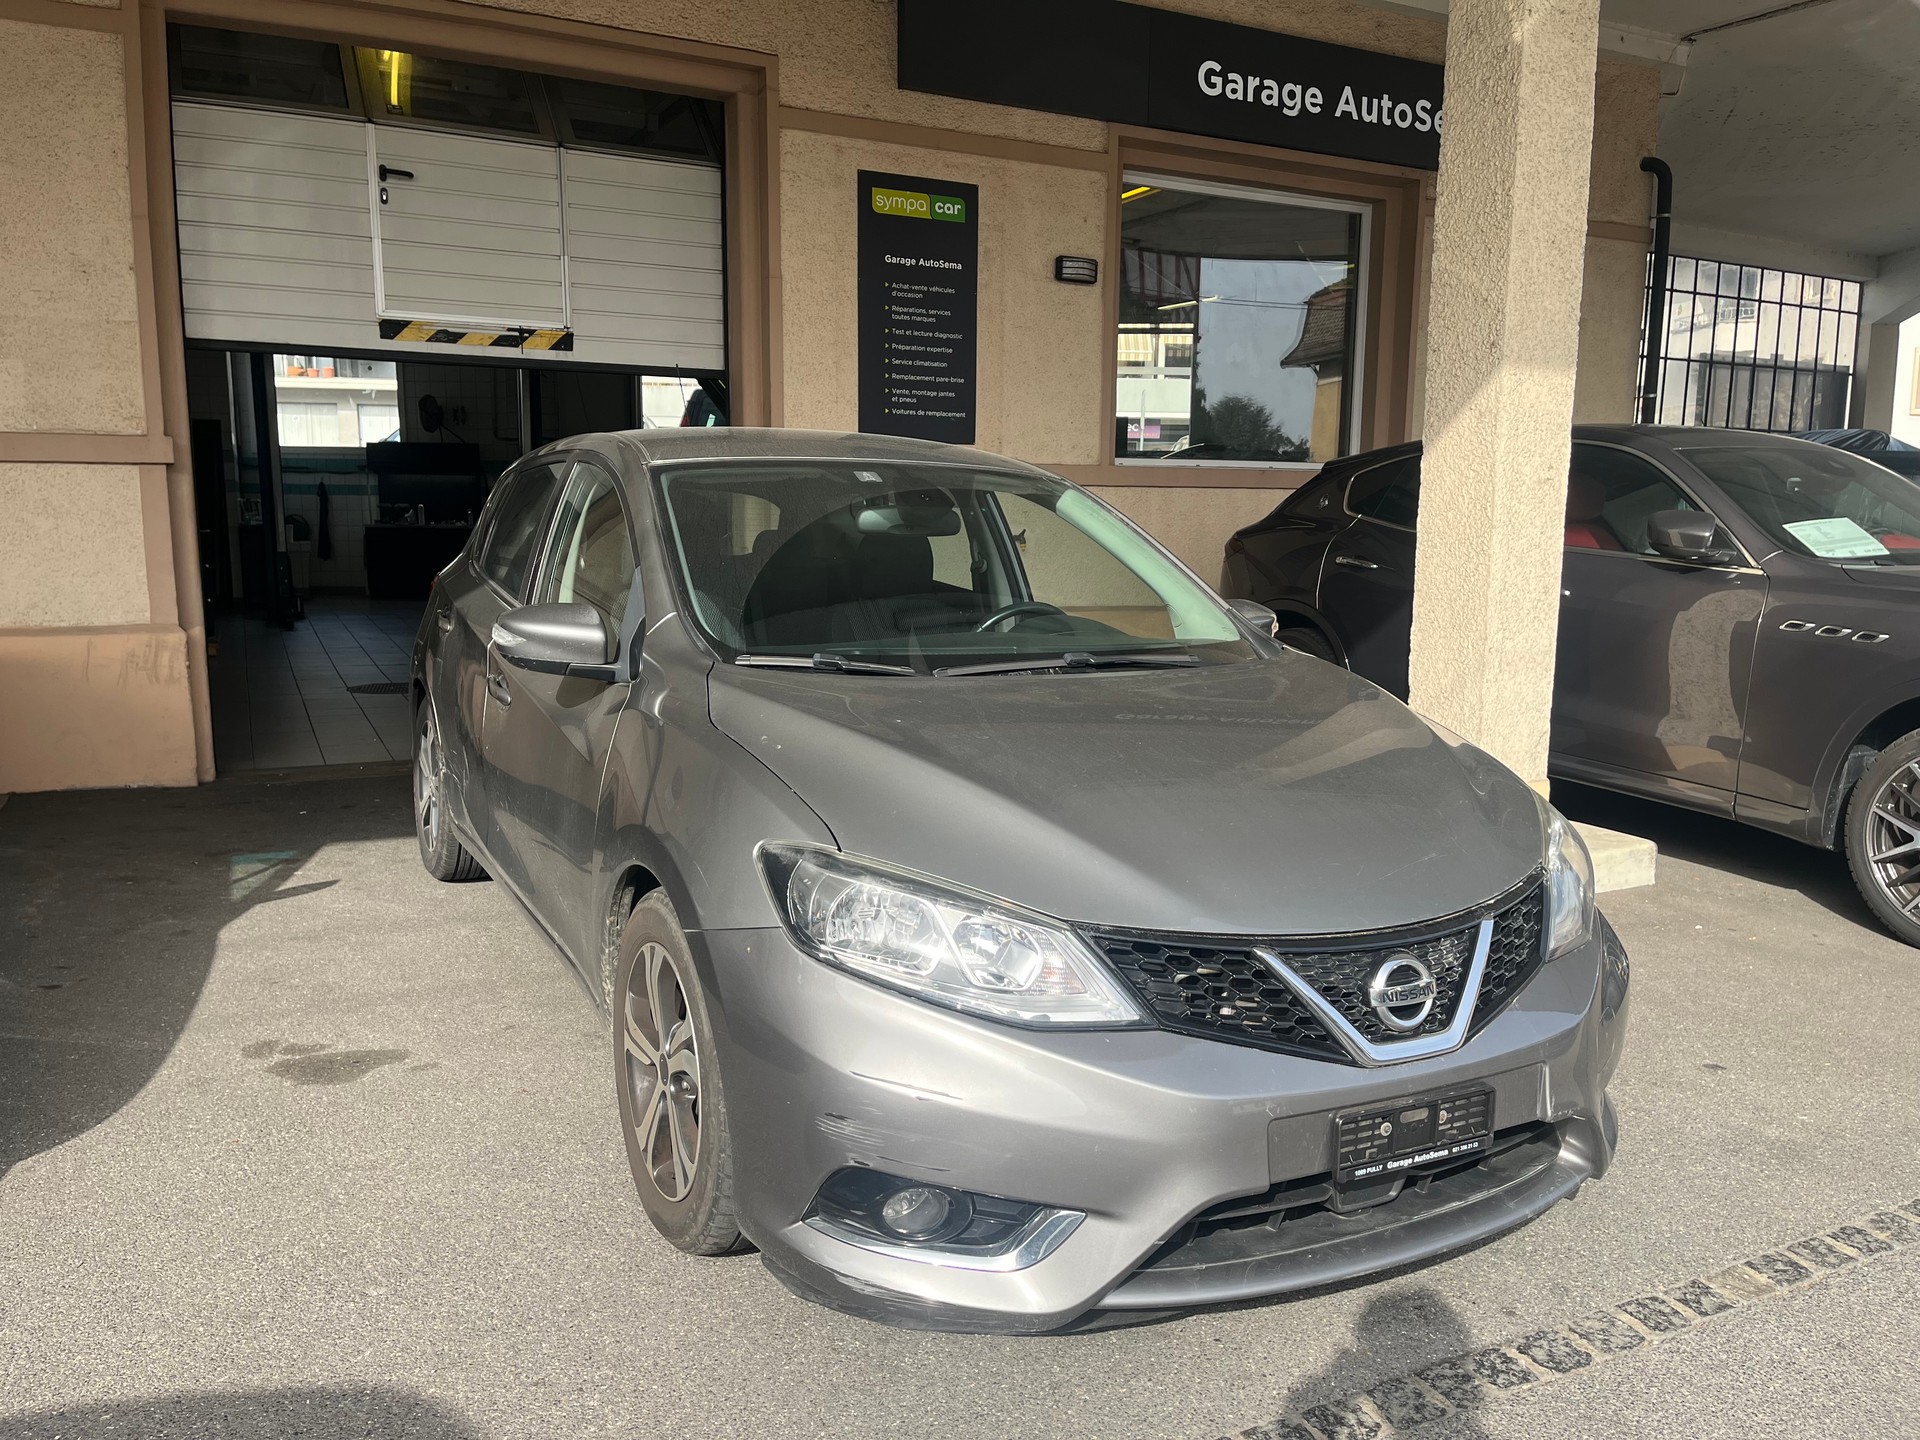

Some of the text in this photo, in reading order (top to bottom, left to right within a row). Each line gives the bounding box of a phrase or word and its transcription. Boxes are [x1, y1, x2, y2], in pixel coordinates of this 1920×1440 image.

[1197, 60, 1323, 117] Garage
[875, 194, 962, 215] sympa car
[884, 254, 962, 270] Garage AutoSema
[891, 282, 956, 294] Achat-vente véhicules
[891, 290, 923, 298] d'occasion
[891, 305, 928, 314] Réparations,
[911, 315, 936, 323] marques
[933, 331, 963, 340] diagnostic
[891, 343, 953, 354] Préparation expertise
[891, 358, 948, 368] Service climatisation
[891, 373, 965, 384] Remplacement pare-brise
[891, 388, 911, 396] Vente,
[911, 389, 937, 397] montage
[891, 408, 917, 416] Voitures
[925, 410, 966, 418] remplacement
[1382, 983, 1435, 1003] NISSAN
[1366, 1164, 1383, 1173] PULLY
[1386, 1157, 1413, 1169] Garage
[1413, 1149, 1449, 1163] AutoSema
